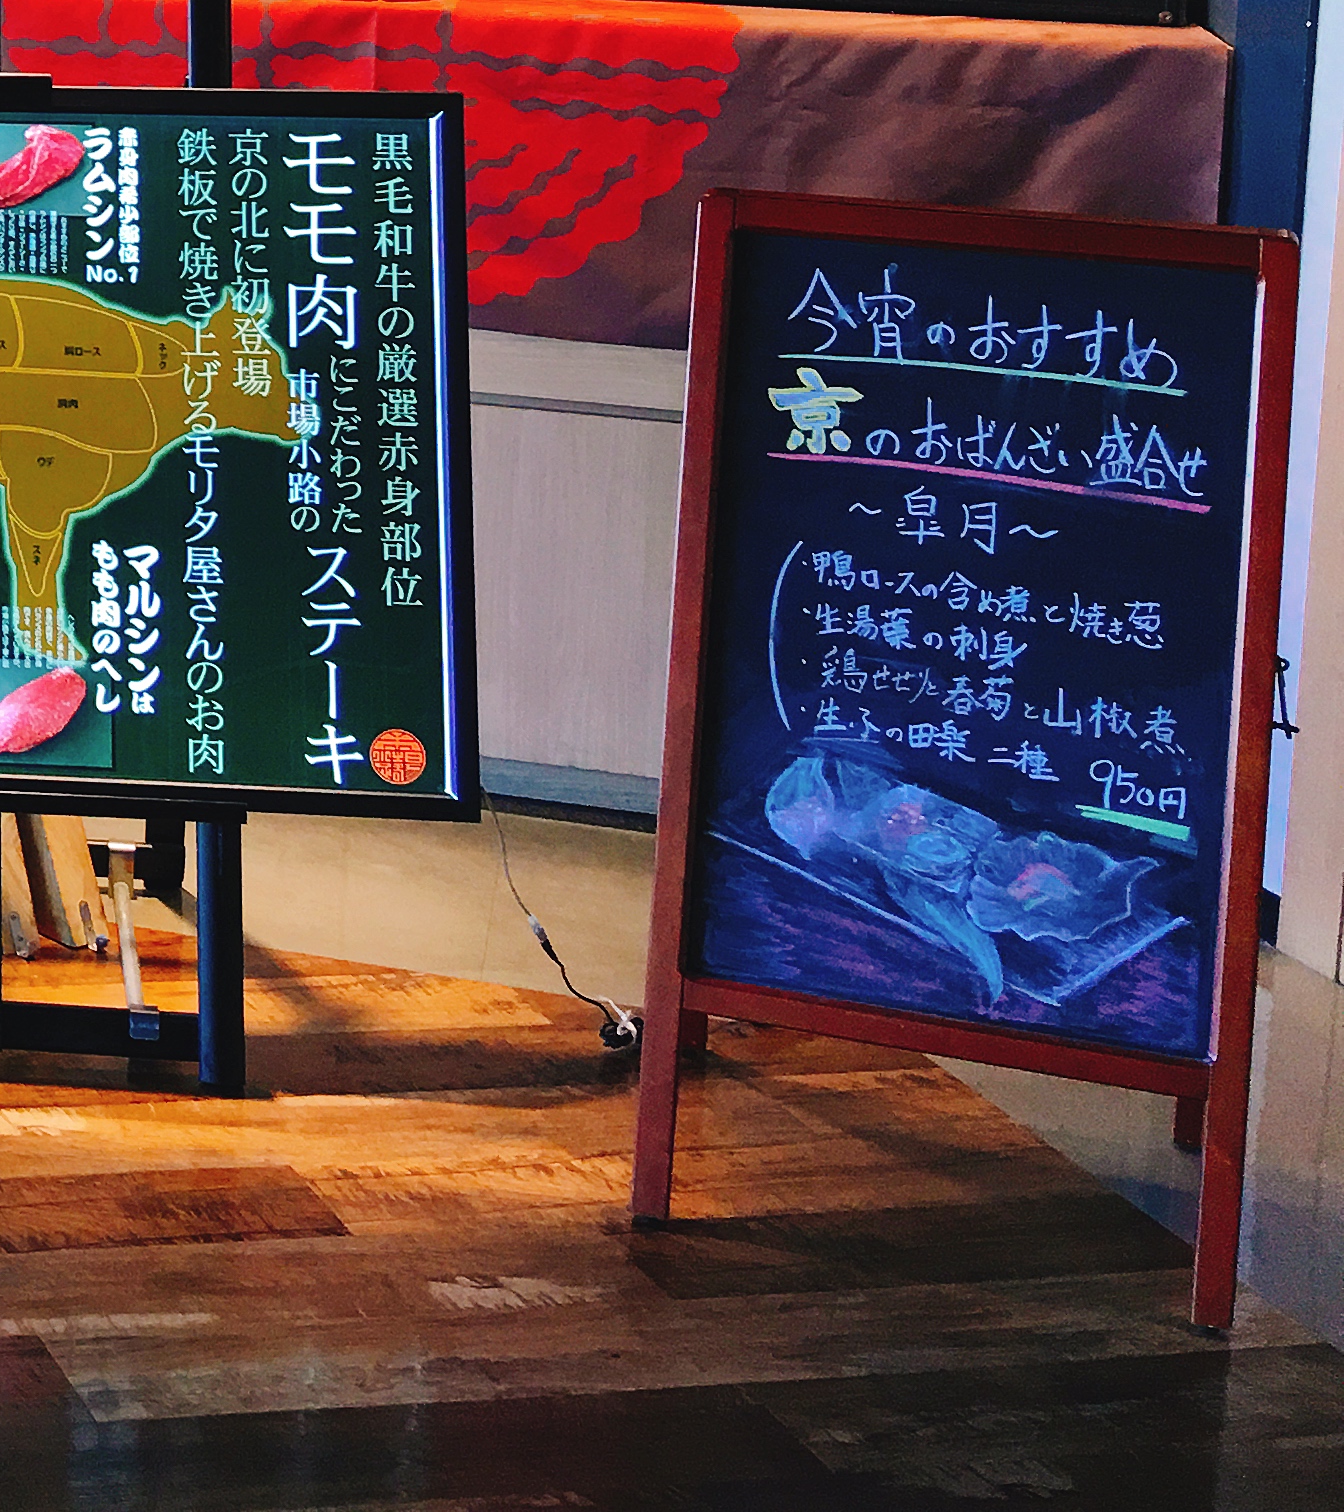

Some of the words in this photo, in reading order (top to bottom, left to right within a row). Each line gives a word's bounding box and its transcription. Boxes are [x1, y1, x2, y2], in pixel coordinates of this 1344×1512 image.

[85, 264, 139, 284] No.1
[228, 128, 272, 398] 京の北に初登場
[788, 264, 1179, 387] 今宵のおすすめ
[176, 128, 225, 775] 鉄板で焼き上げるモリタ屋さんのお肉
[286, 368, 322, 533] 市場小路の
[371, 132, 424, 607] 黒毛和牛の厳選赤身部位
[767, 367, 1208, 497] 京のおばんざい盛合せ
[123, 544, 161, 716] マルシンは
[1088, 759, 1187, 820] 950円
